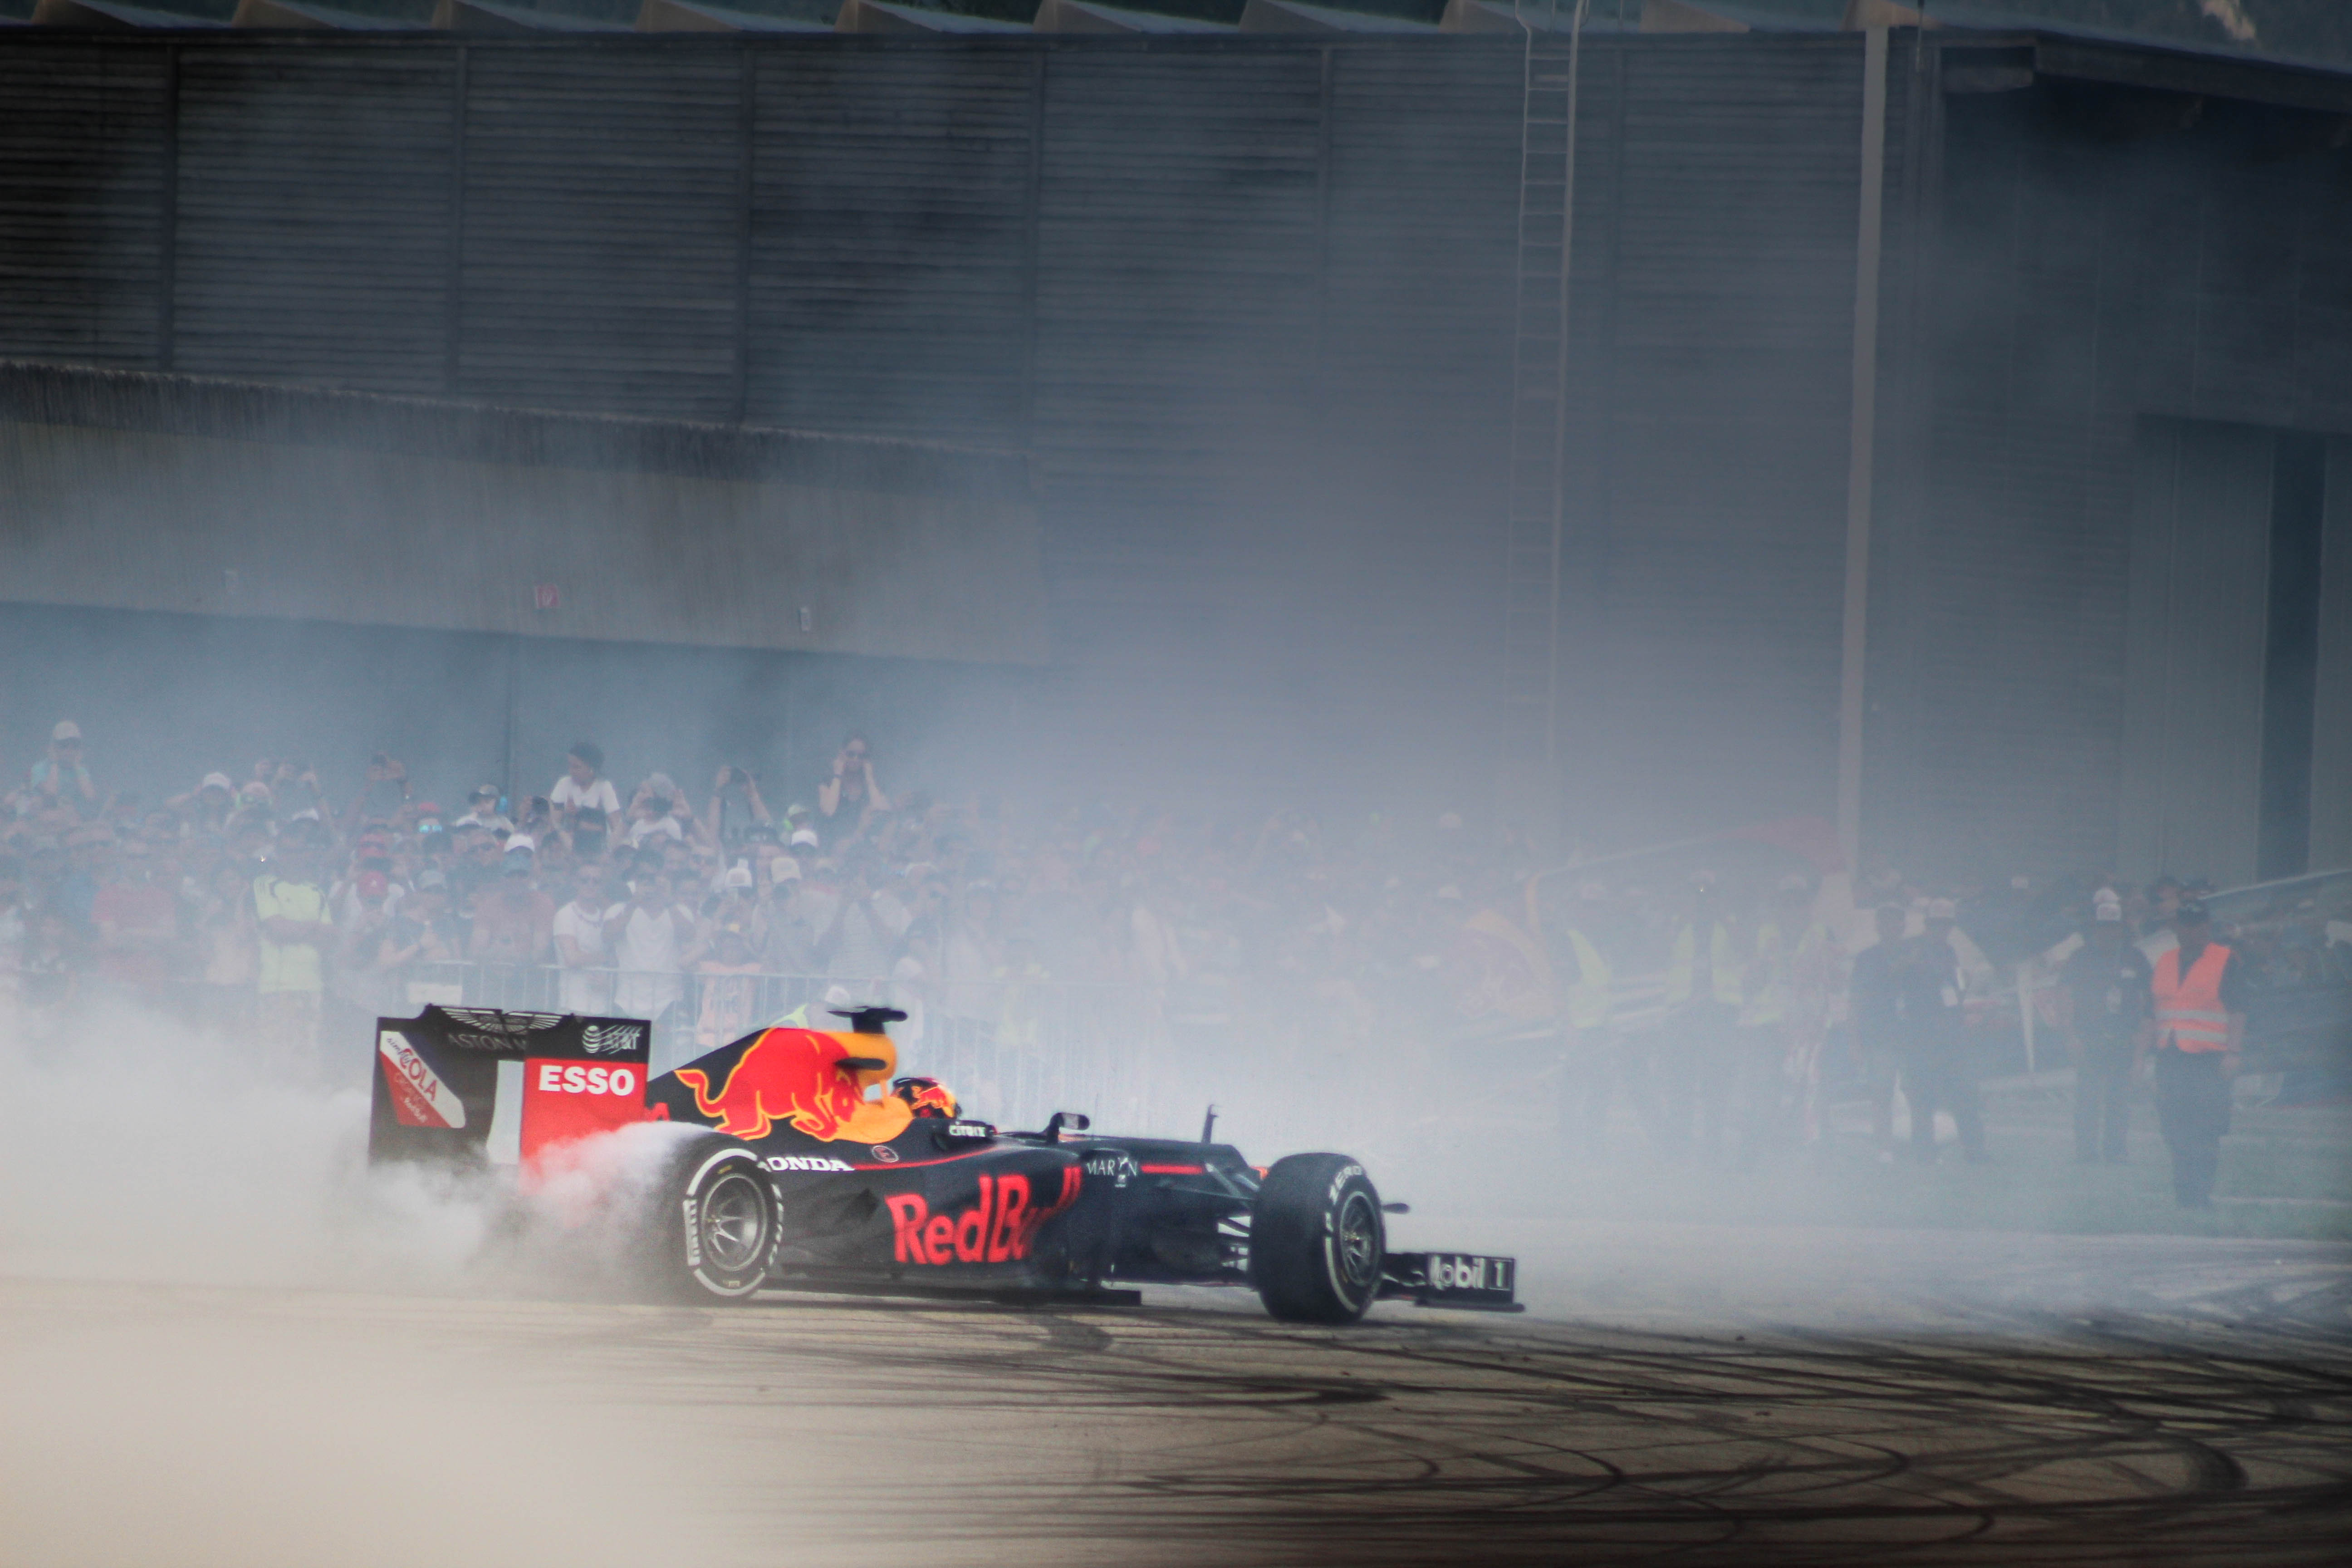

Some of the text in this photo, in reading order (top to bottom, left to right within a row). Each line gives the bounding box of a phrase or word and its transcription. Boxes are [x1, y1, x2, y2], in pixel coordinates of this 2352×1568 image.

[399, 1048, 437, 1102] COLA
[539, 1065, 635, 1096] ESSO
[884, 1172, 992, 1265] Red
